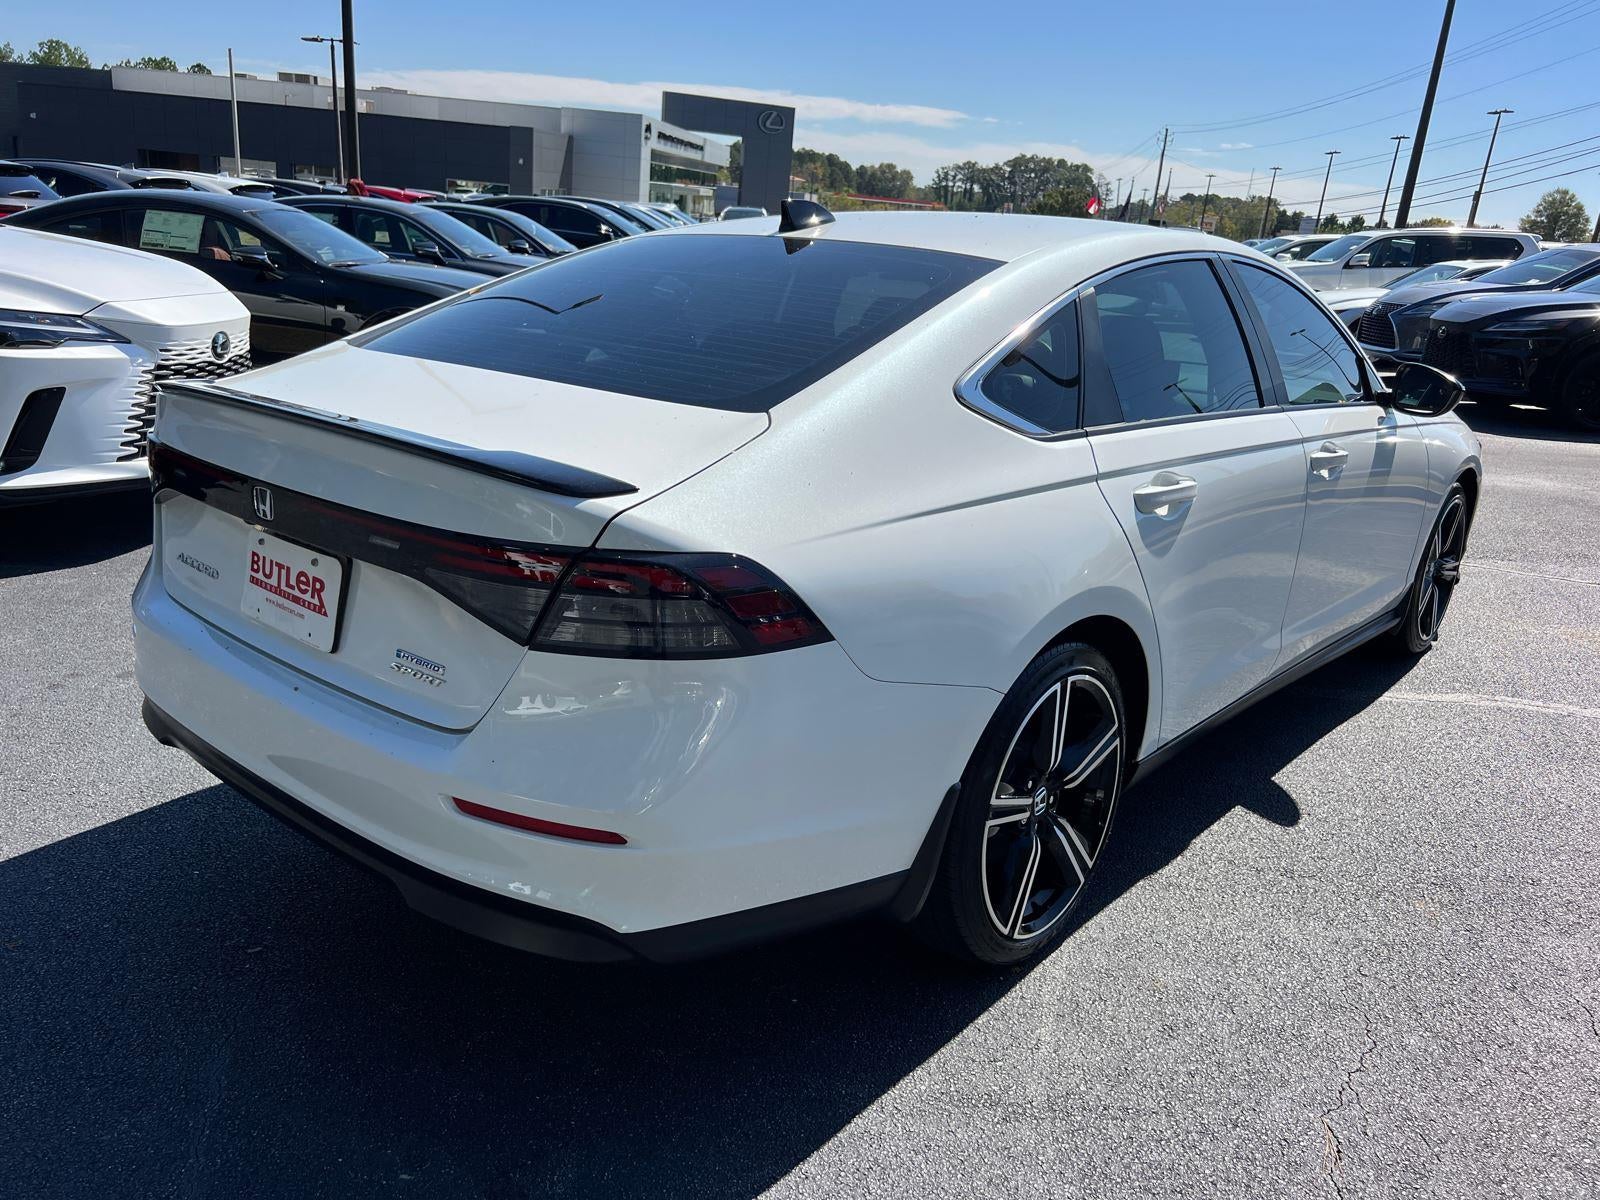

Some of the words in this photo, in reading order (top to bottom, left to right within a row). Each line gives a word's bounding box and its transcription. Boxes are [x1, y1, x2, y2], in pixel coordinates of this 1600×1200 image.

[177, 552, 219, 580] ACCORD
[391, 661, 447, 688] SPORT
[401, 652, 440, 672] HYBRID
